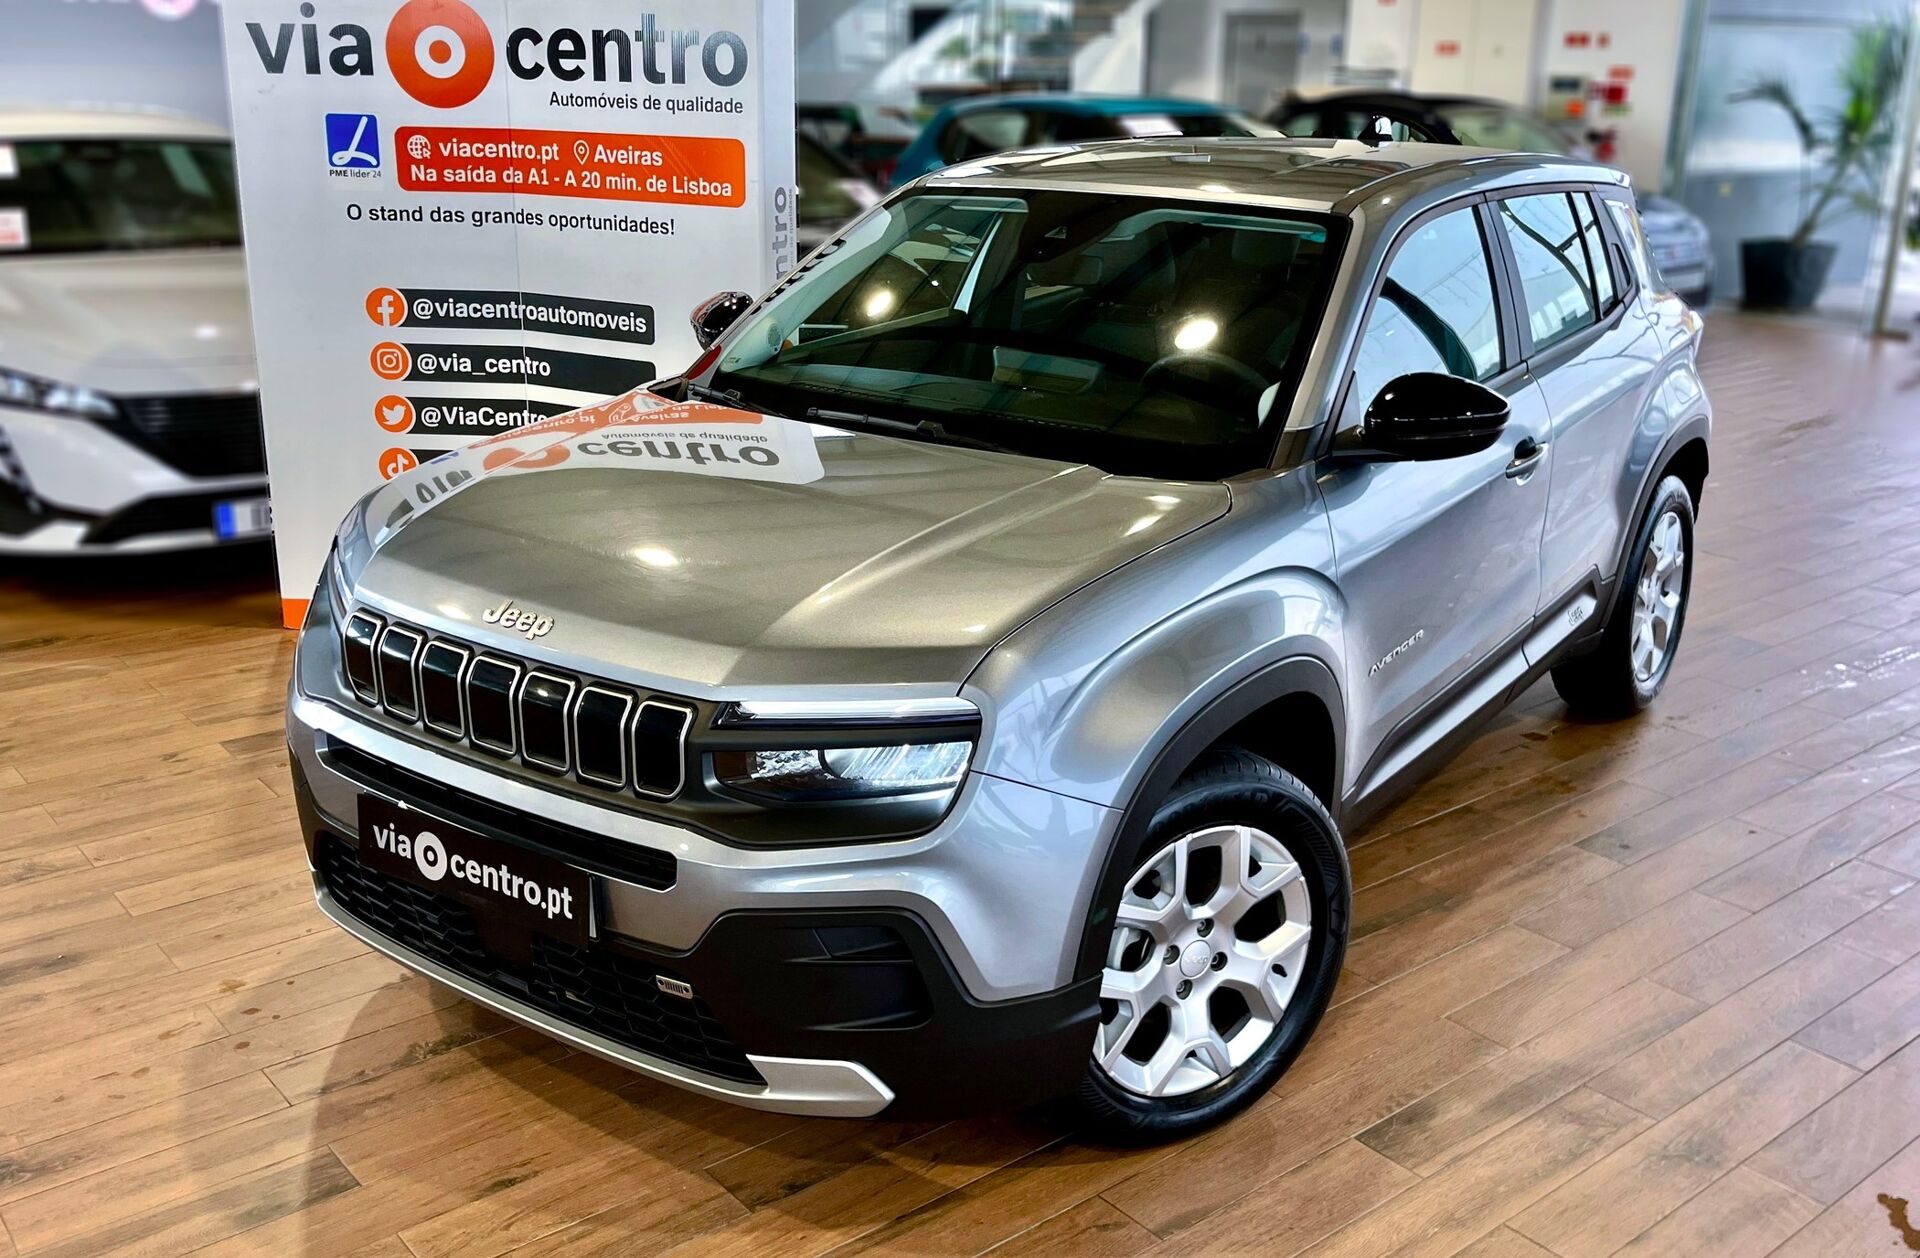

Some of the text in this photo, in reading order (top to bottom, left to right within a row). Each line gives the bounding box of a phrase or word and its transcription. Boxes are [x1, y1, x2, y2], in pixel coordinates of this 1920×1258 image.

[245, 2, 748, 87] via centro
[549, 91, 743, 115] Automóveis de qualidade
[438, 138, 663, 166] viacentro.pt Aveiras
[329, 169, 349, 177] PME
[411, 165, 437, 181] Na
[443, 165, 497, 183] saída
[502, 166, 523, 184] da
[528, 168, 549, 185] A1
[564, 170, 577, 187] A
[581, 171, 601, 188] 20
[605, 173, 642, 191] min.
[646, 175, 667, 193] de
[672, 176, 732, 197] Lisboa
[347, 204, 675, 236] O stand das grandes oportunidades!
[772, 187, 789, 281] ntro
[413, 298, 647, 333] @viacentroautomoveis
[417, 353, 551, 377] @via_centro
[482, 600, 555, 640] Jeep
[1367, 629, 1424, 677] AVENGER
[373, 823, 573, 920] via centro.pt
